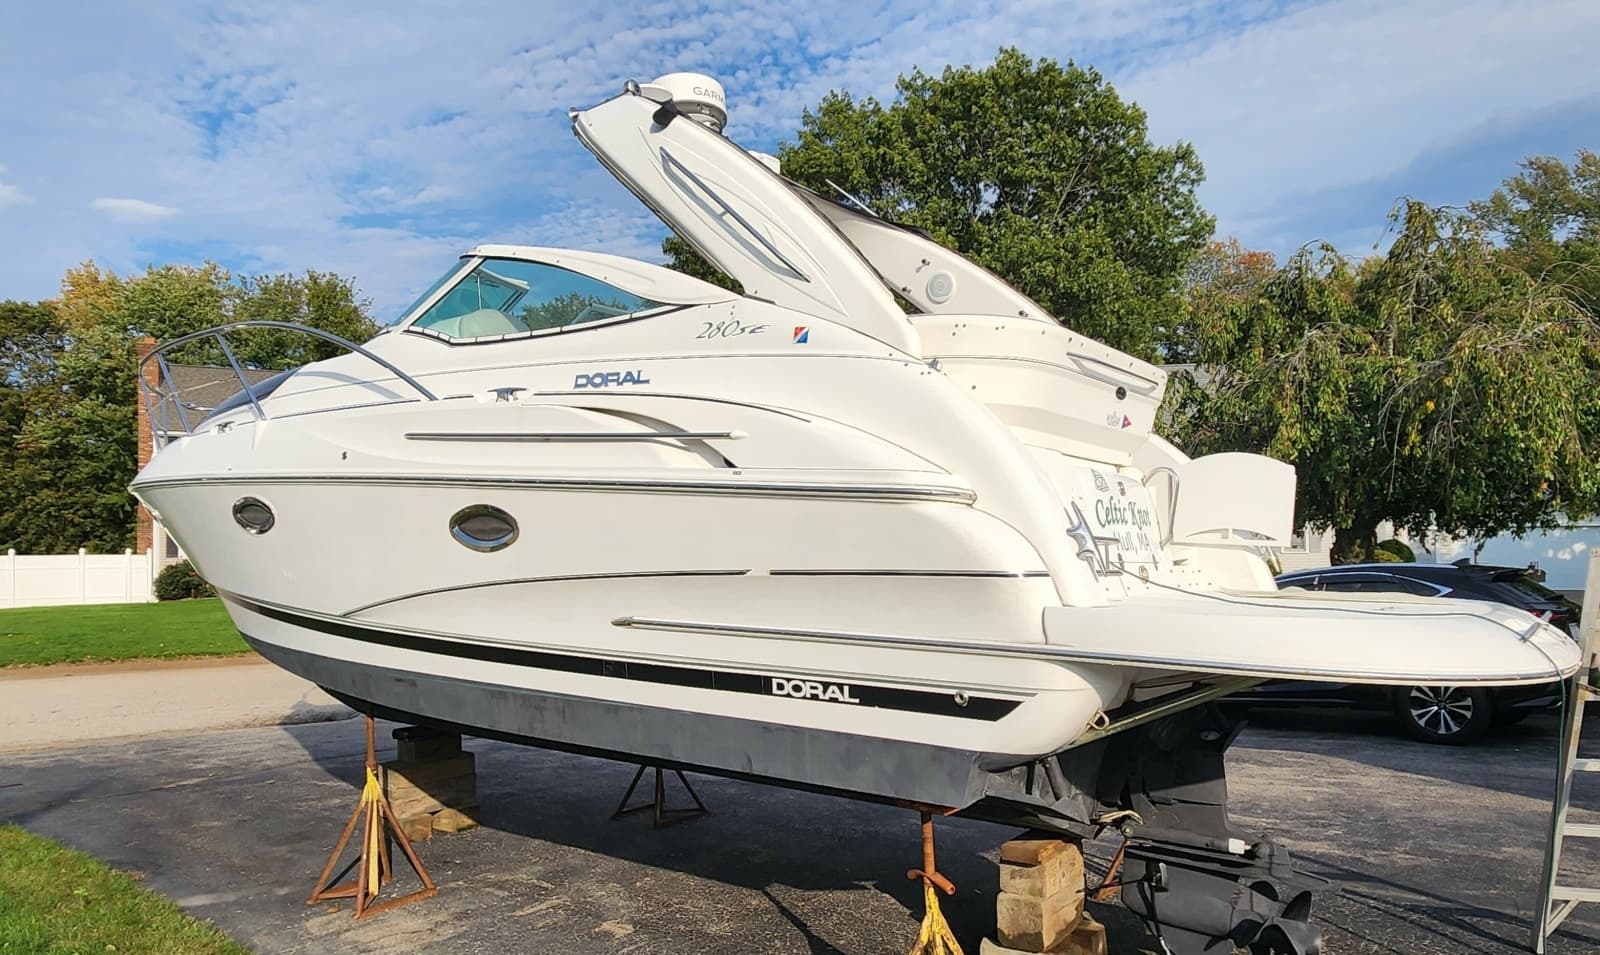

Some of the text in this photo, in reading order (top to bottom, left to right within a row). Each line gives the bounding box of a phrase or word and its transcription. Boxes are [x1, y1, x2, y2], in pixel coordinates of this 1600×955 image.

[573, 370, 650, 389] DORAL
[1096, 496, 1151, 531] Celtic Knot
[771, 678, 860, 703] DORAL
